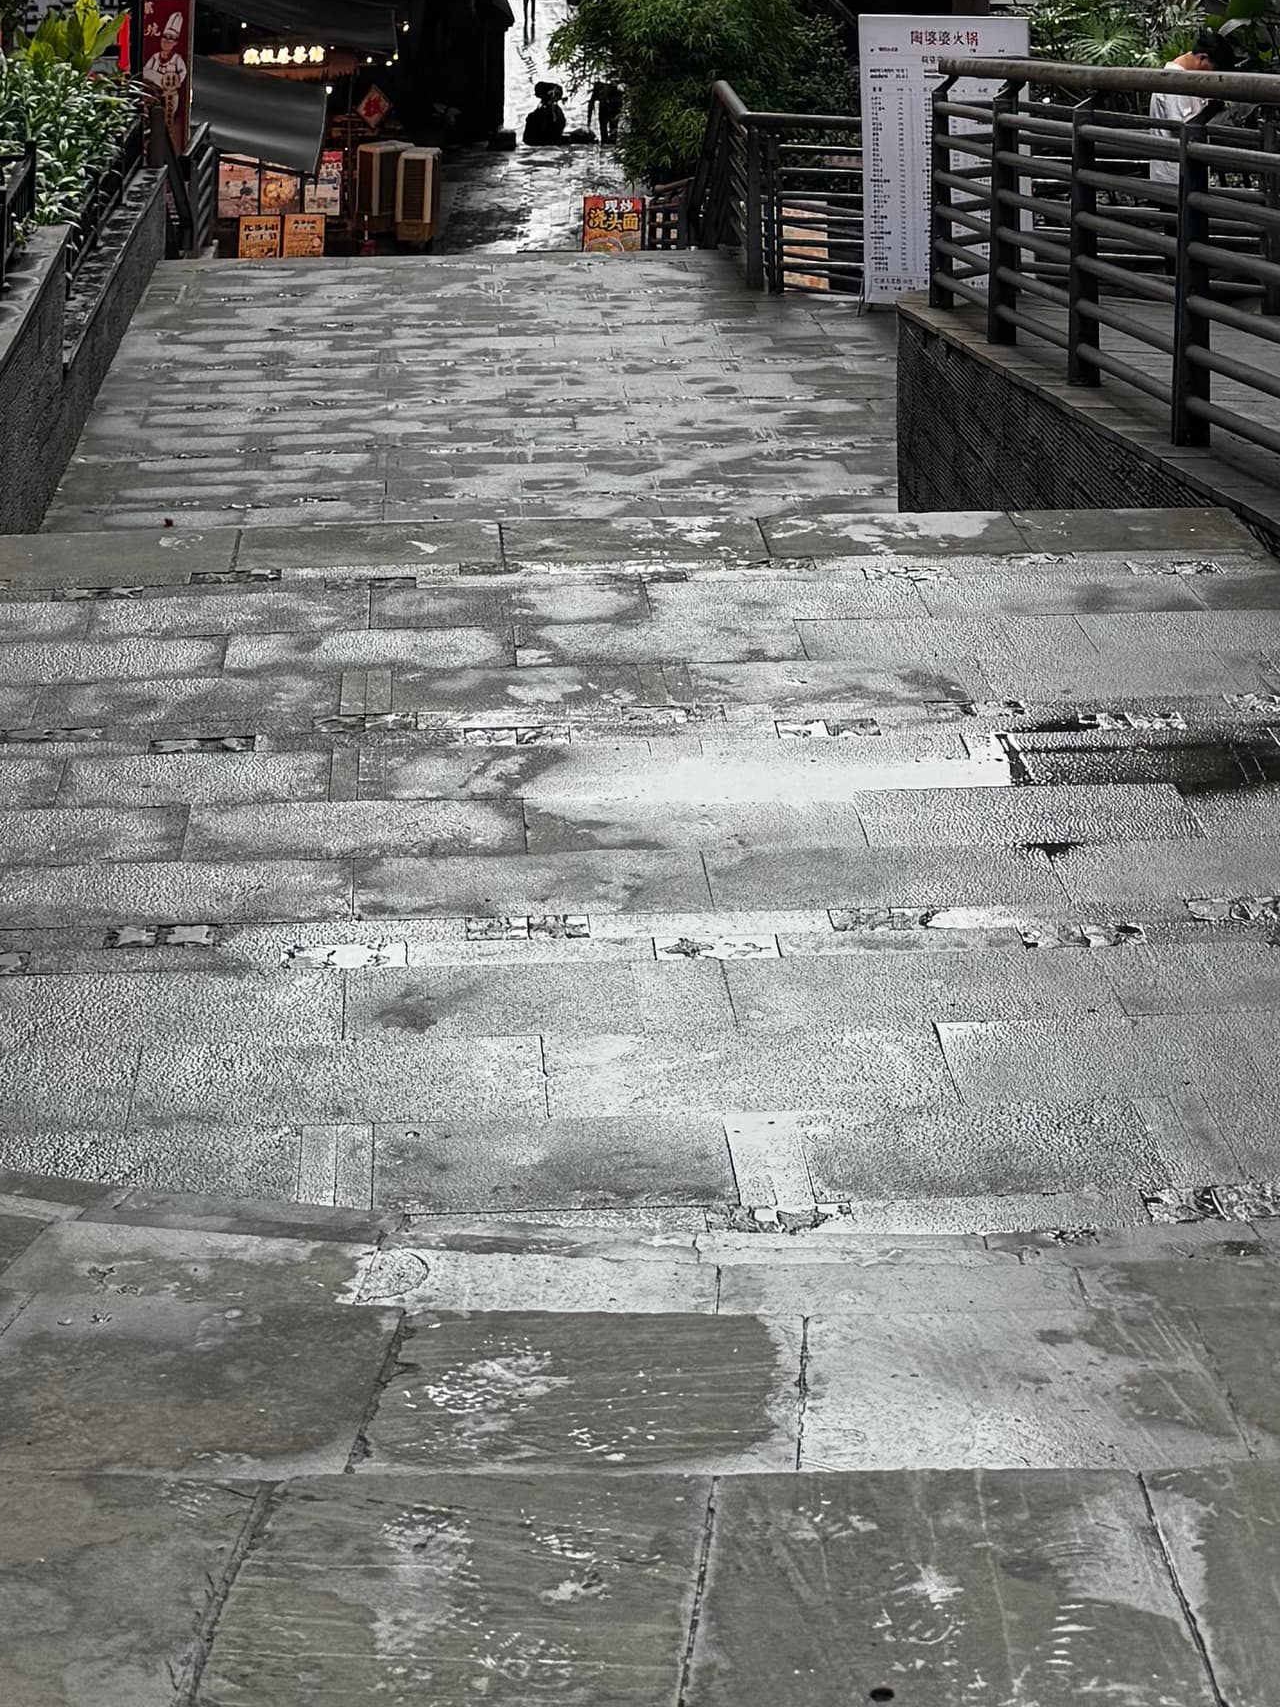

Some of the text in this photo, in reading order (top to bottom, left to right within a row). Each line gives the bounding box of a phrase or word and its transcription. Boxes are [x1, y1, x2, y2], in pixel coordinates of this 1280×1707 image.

[910, 30, 979, 46] 陶婆婆火锅
[604, 199, 634, 213] 现炒
[588, 208, 639, 231] 浇头面
